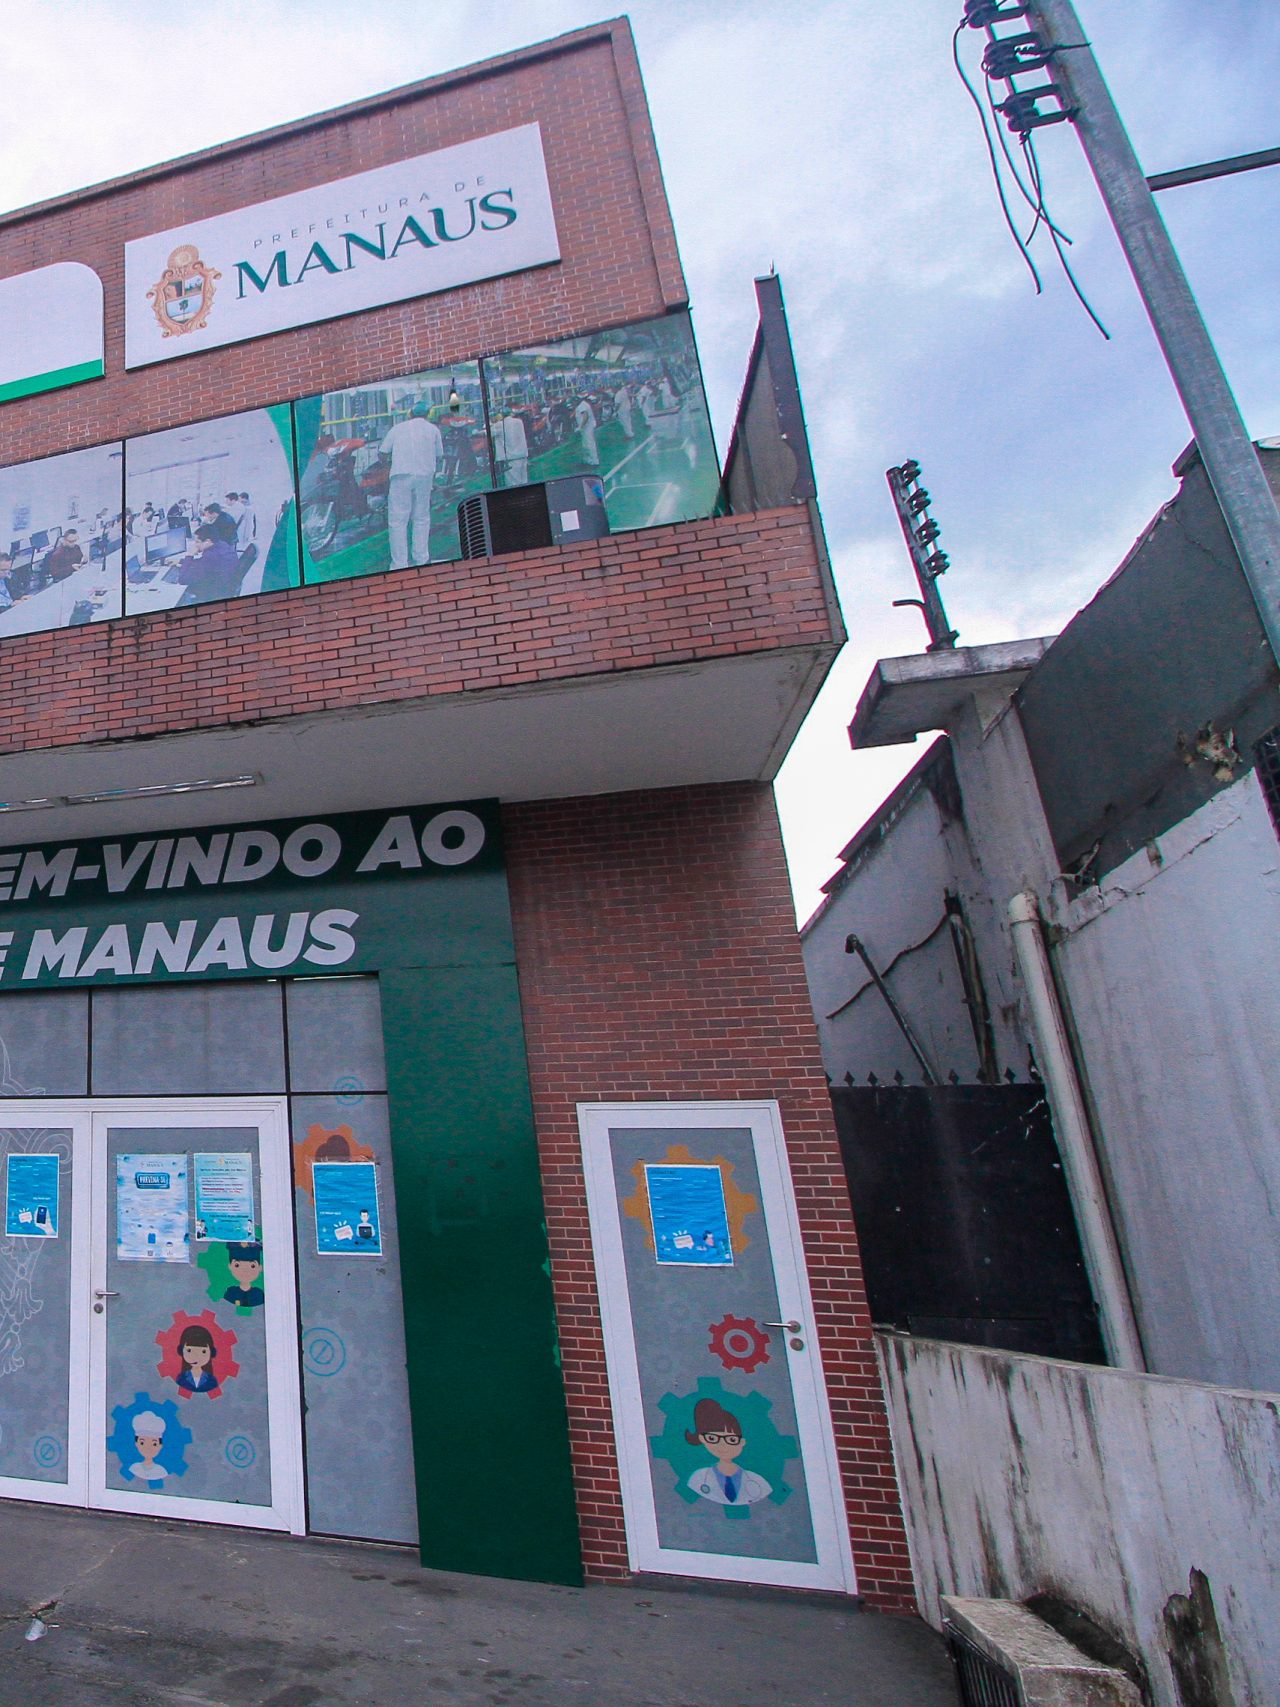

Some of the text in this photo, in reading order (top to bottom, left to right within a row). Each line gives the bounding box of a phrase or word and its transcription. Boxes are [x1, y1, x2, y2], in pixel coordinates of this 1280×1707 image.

[233, 188, 518, 300] MANAUS
[252, 175, 486, 249] PREFEITURA DE
[357, 810, 486, 872] AO
[22, 909, 360, 980] MANAUS
